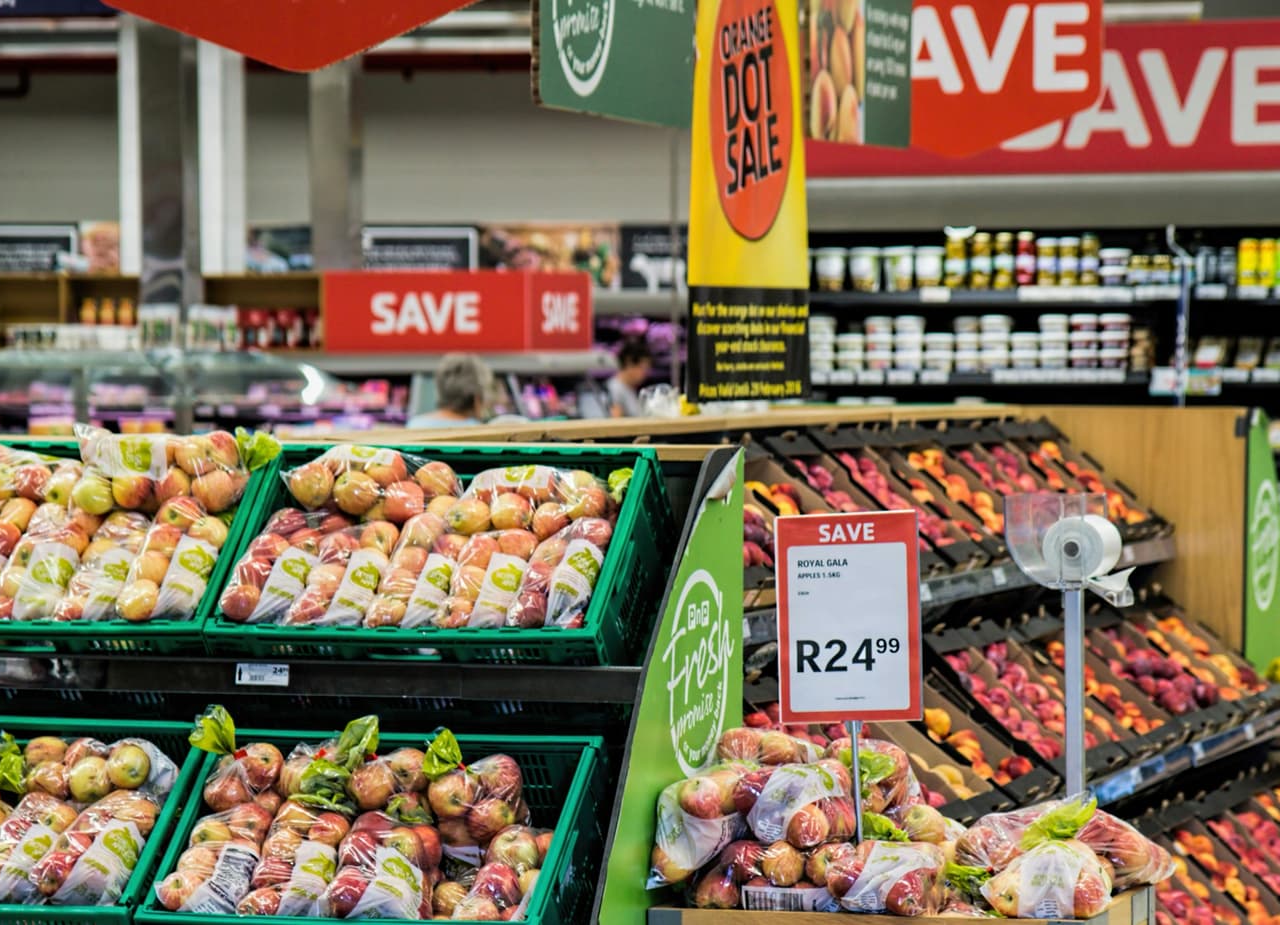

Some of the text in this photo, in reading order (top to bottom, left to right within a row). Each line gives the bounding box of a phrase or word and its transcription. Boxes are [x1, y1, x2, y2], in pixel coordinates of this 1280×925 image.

[721, 5, 774, 62] ORANGE
[723, 45, 774, 134] DOT
[726, 113, 783, 197] SALE
[370, 291, 480, 335] SAVE
[541, 291, 580, 334] SAVE
[818, 522, 876, 543] SAVE
[797, 558, 849, 568] ROYAL GALA
[797, 572, 821, 580] APPLES
[687, 600, 711, 631] PnP
[662, 592, 735, 705] Fresh
[675, 692, 714, 750] promise
